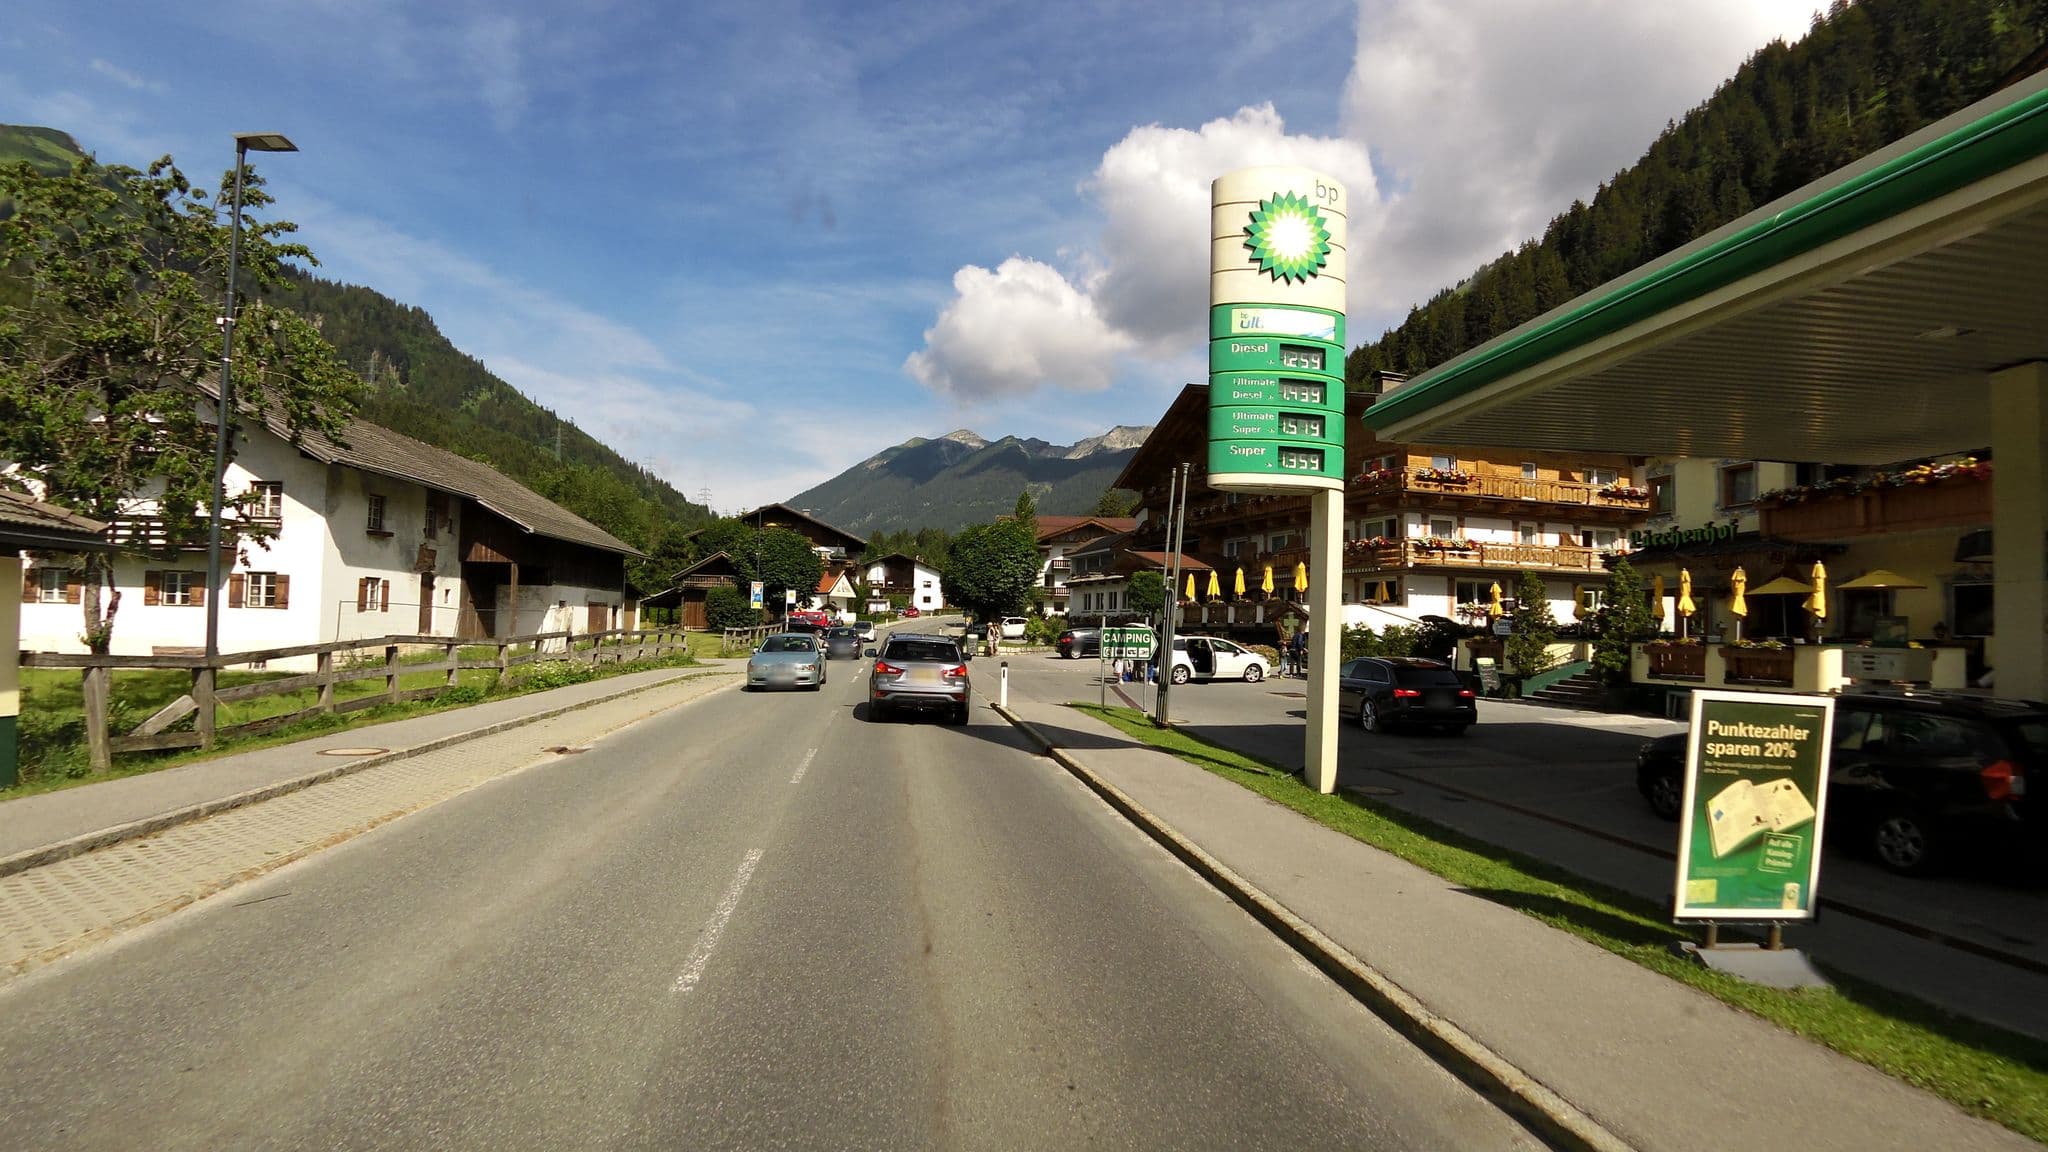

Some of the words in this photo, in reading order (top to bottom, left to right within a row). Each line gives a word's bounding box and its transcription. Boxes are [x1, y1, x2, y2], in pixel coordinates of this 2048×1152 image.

[1315, 179, 1338, 205] bp
[1231, 343, 1268, 353] Diesel
[1233, 377, 1276, 386] Ultimate
[1232, 390, 1262, 399] Diesel
[1232, 411, 1275, 421] Ultimate
[1232, 425, 1261, 434] Super
[1282, 419, 1320, 437] 1.519
[1230, 445, 1266, 456] Super
[1282, 452, 1319, 470] 1.359
[1103, 633, 1151, 643] CAMPING
[1707, 720, 1810, 740] Punktezahler
[1705, 742, 1760, 758] sparen
[1763, 742, 1798, 758] 20%
